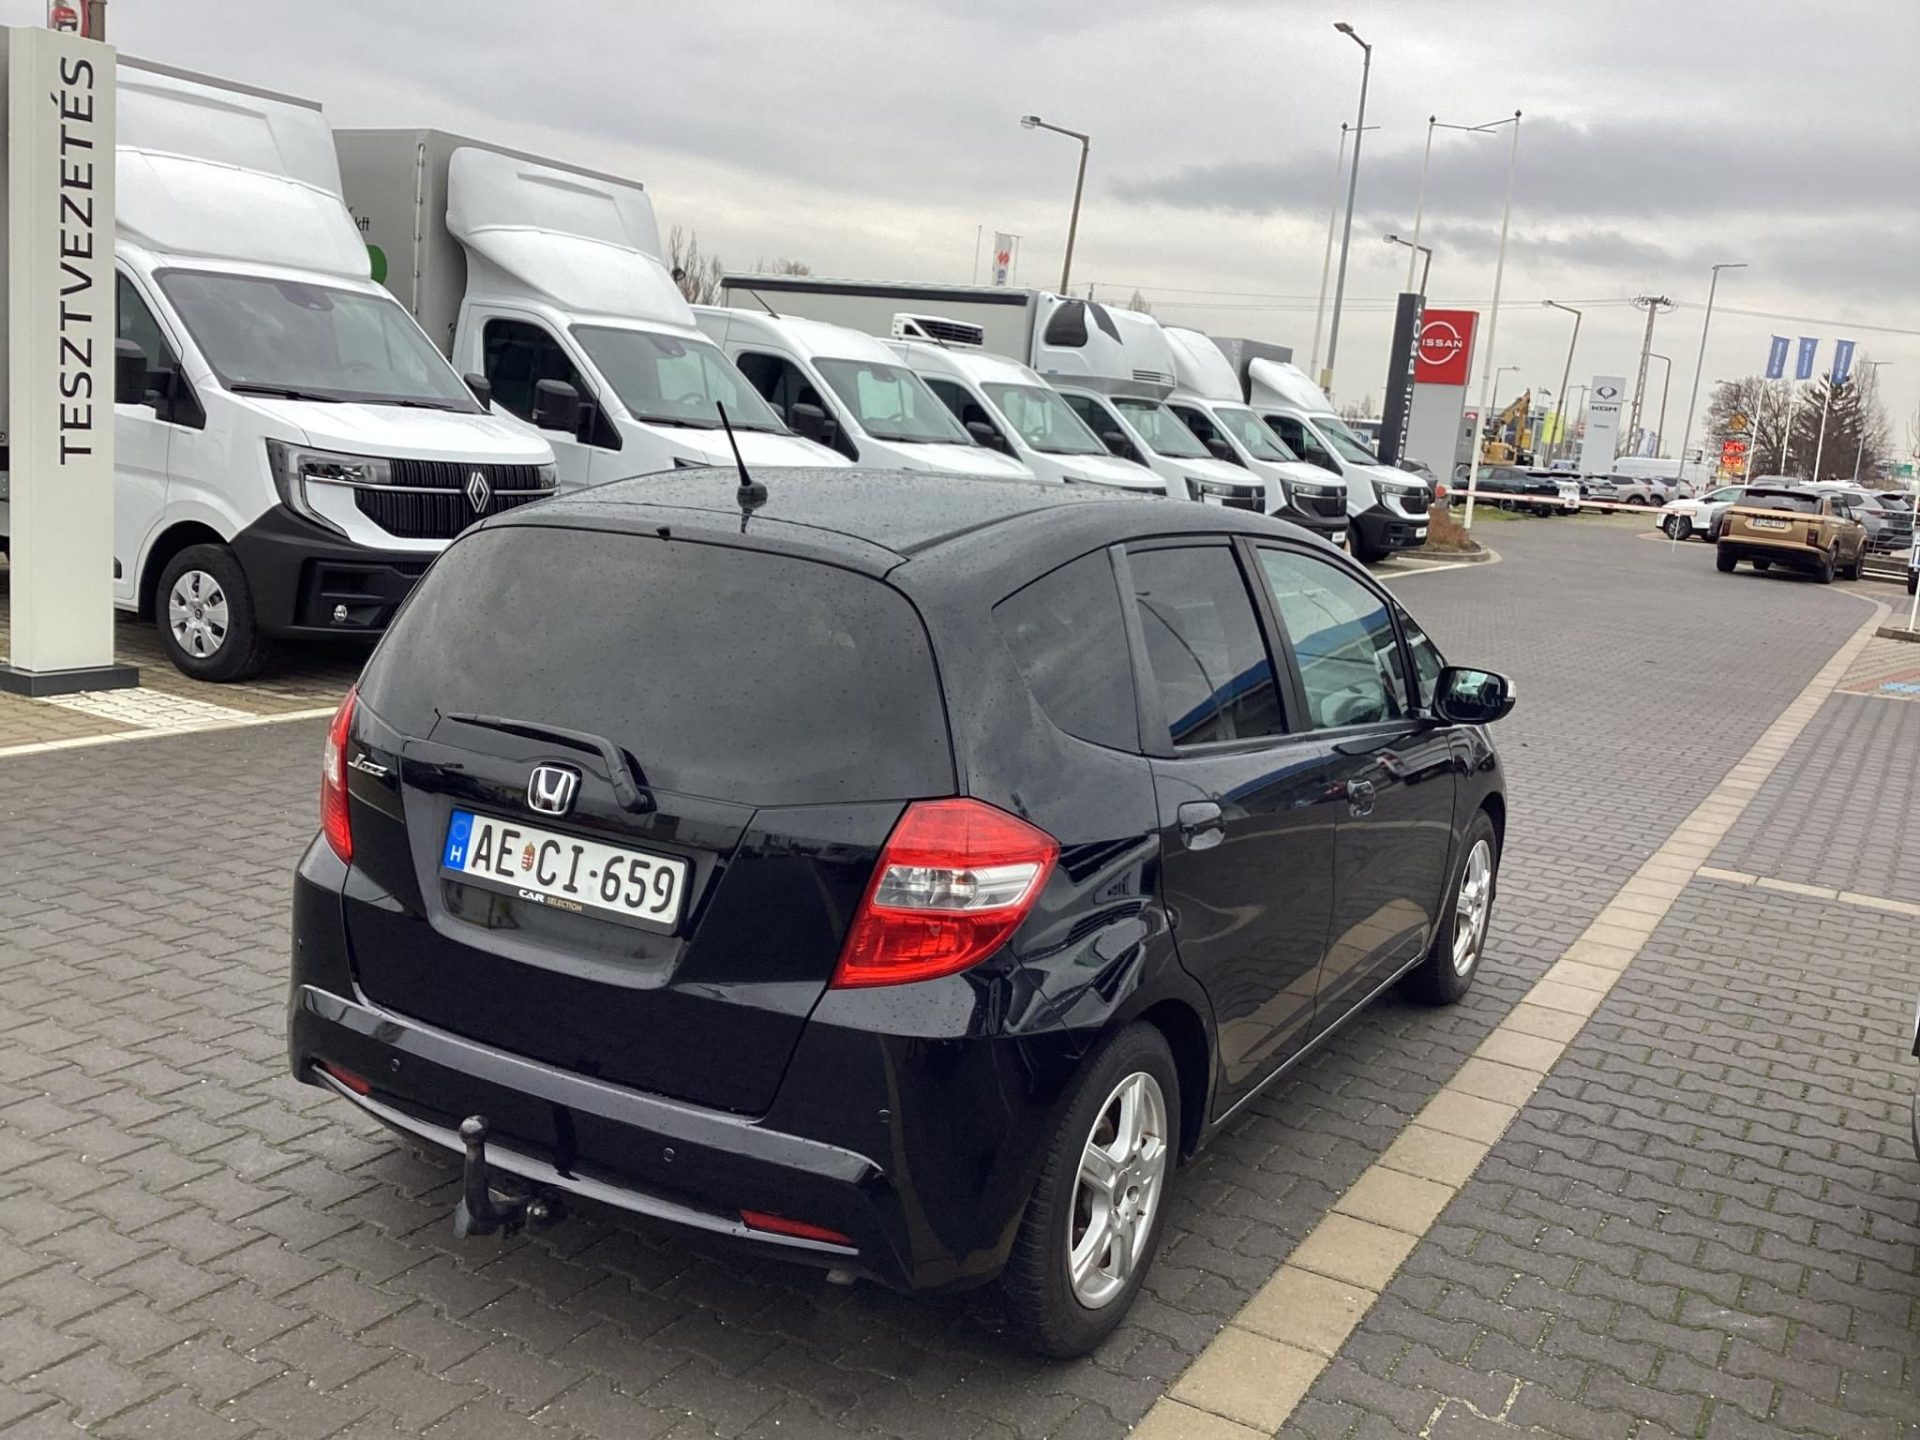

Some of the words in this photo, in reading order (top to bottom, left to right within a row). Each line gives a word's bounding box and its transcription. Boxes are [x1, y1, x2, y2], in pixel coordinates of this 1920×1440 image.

[51, 56, 95, 466] TESZTVEZETÉS
[1422, 338, 1463, 349] ISSAN
[450, 844, 463, 862] H
[518, 888, 545, 903] CAR
[546, 896, 582, 913] SELECTION
